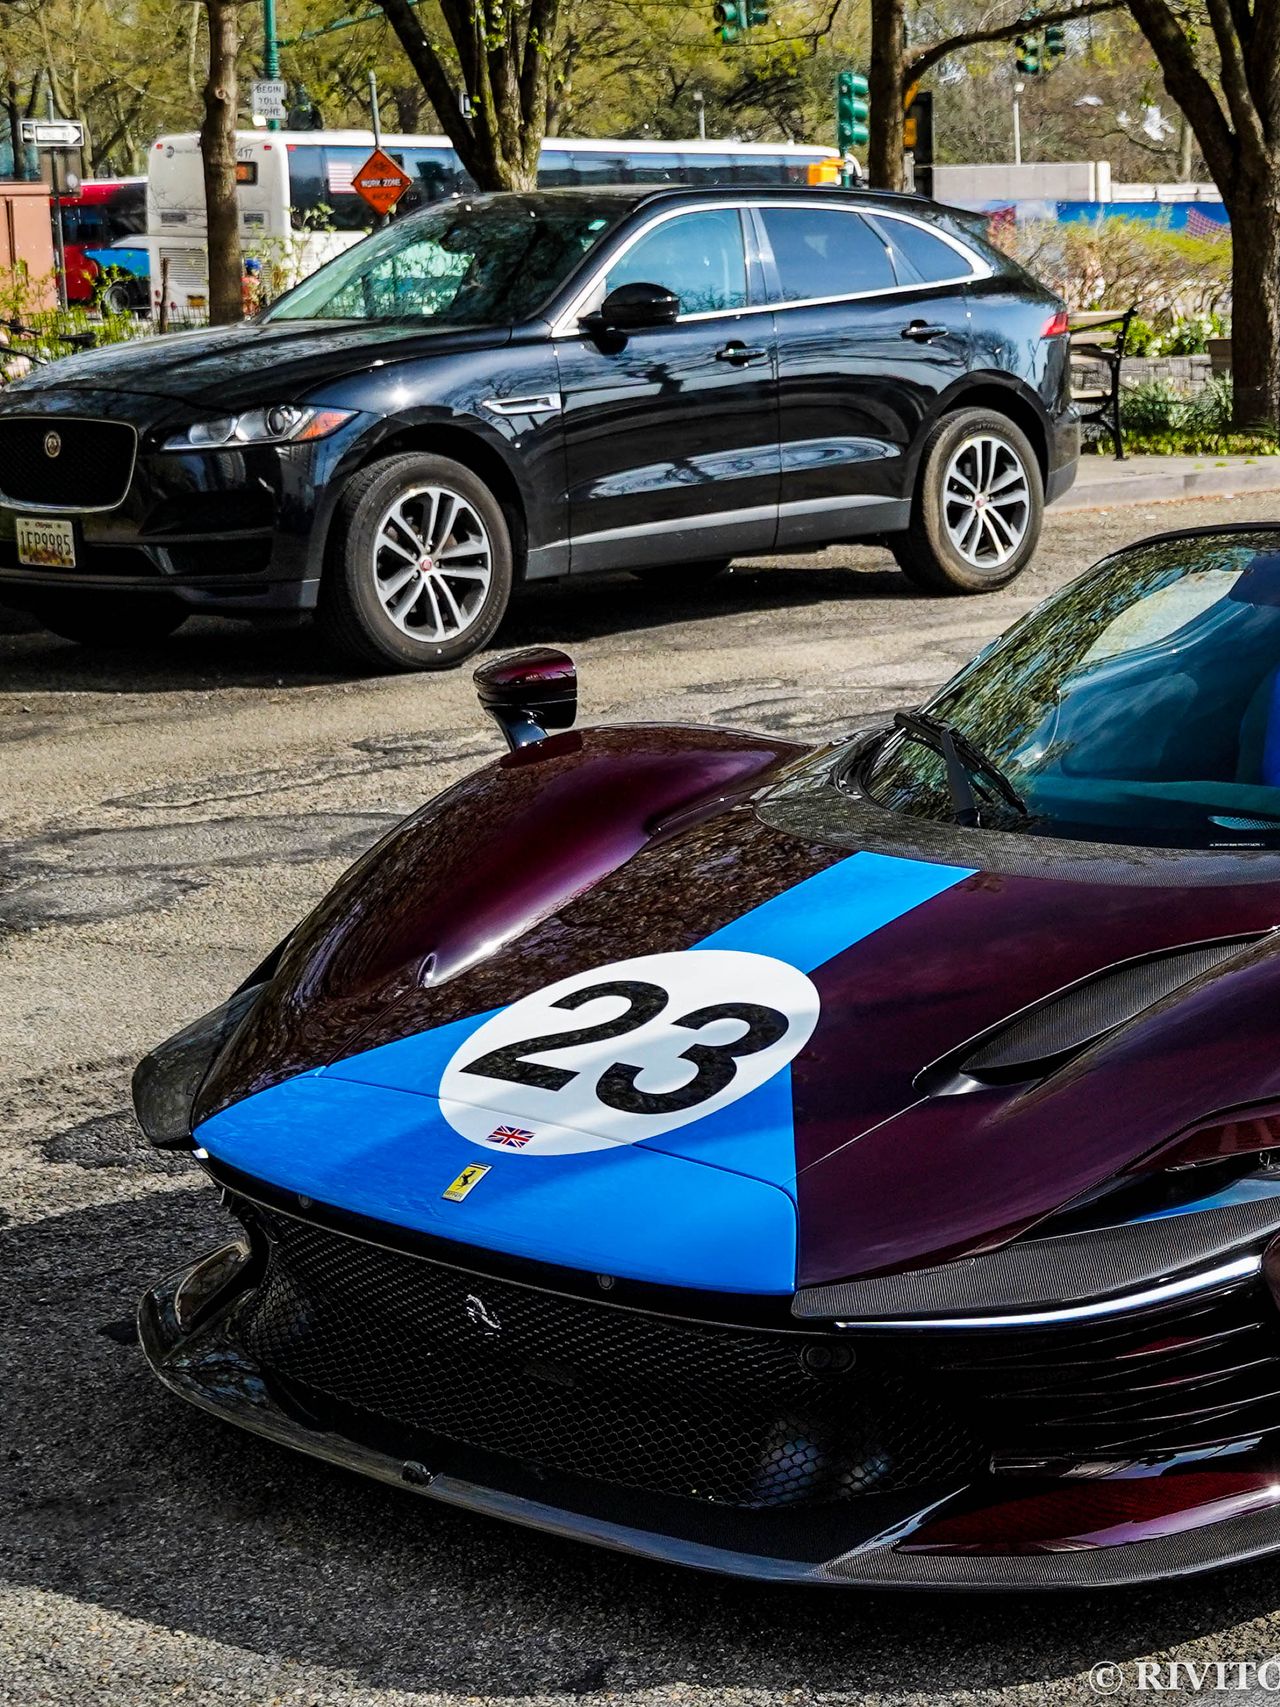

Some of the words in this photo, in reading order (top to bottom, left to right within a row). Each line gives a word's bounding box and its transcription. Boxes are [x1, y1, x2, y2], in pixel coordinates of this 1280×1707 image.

[256, 84, 282, 93] BEGIN
[258, 97, 280, 105] TOLL
[258, 107, 282, 116] ZONE
[459, 981, 789, 1115] 23
